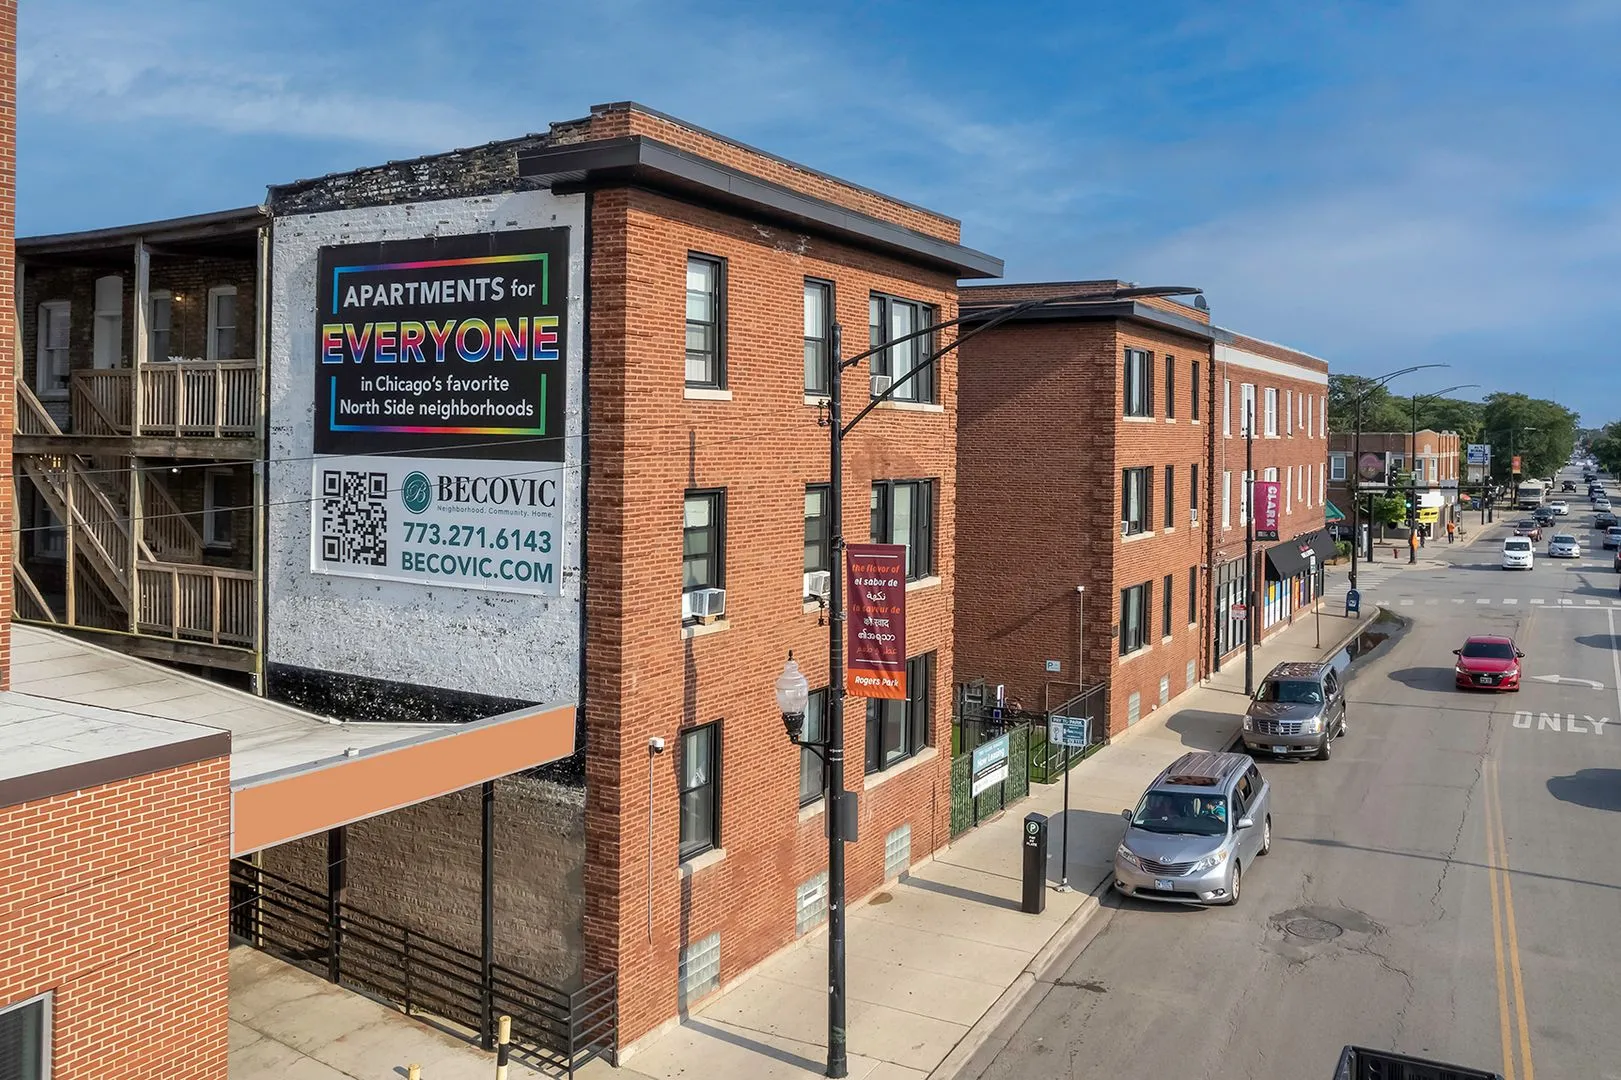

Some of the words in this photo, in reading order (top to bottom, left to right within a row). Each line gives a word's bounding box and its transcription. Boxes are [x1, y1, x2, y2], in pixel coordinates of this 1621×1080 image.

[343, 276, 505, 308] APARTMENTS
[510, 278, 536, 297] for
[321, 315, 560, 364] EVERYONE
[361, 376, 373, 391] in
[446, 374, 510, 391] favorite
[340, 399, 380, 415] North
[384, 399, 415, 416] Side
[419, 399, 534, 420] neighborhoods
[437, 474, 557, 508] BECOVIC
[1266, 485, 1278, 527] CLARK
[403, 521, 552, 554] 773.271.6143
[402, 551, 553, 584] BECOVIC.COM
[852, 564, 865, 573] the
[891, 565, 901, 574] of
[854, 577, 863, 586] el
[863, 577, 887, 587] sabor
[888, 578, 899, 588] de
[890, 606, 901, 614] de
[855, 675, 881, 686] Rogers
[882, 677, 899, 687] Park
[1512, 711, 1610, 735] ONLY
